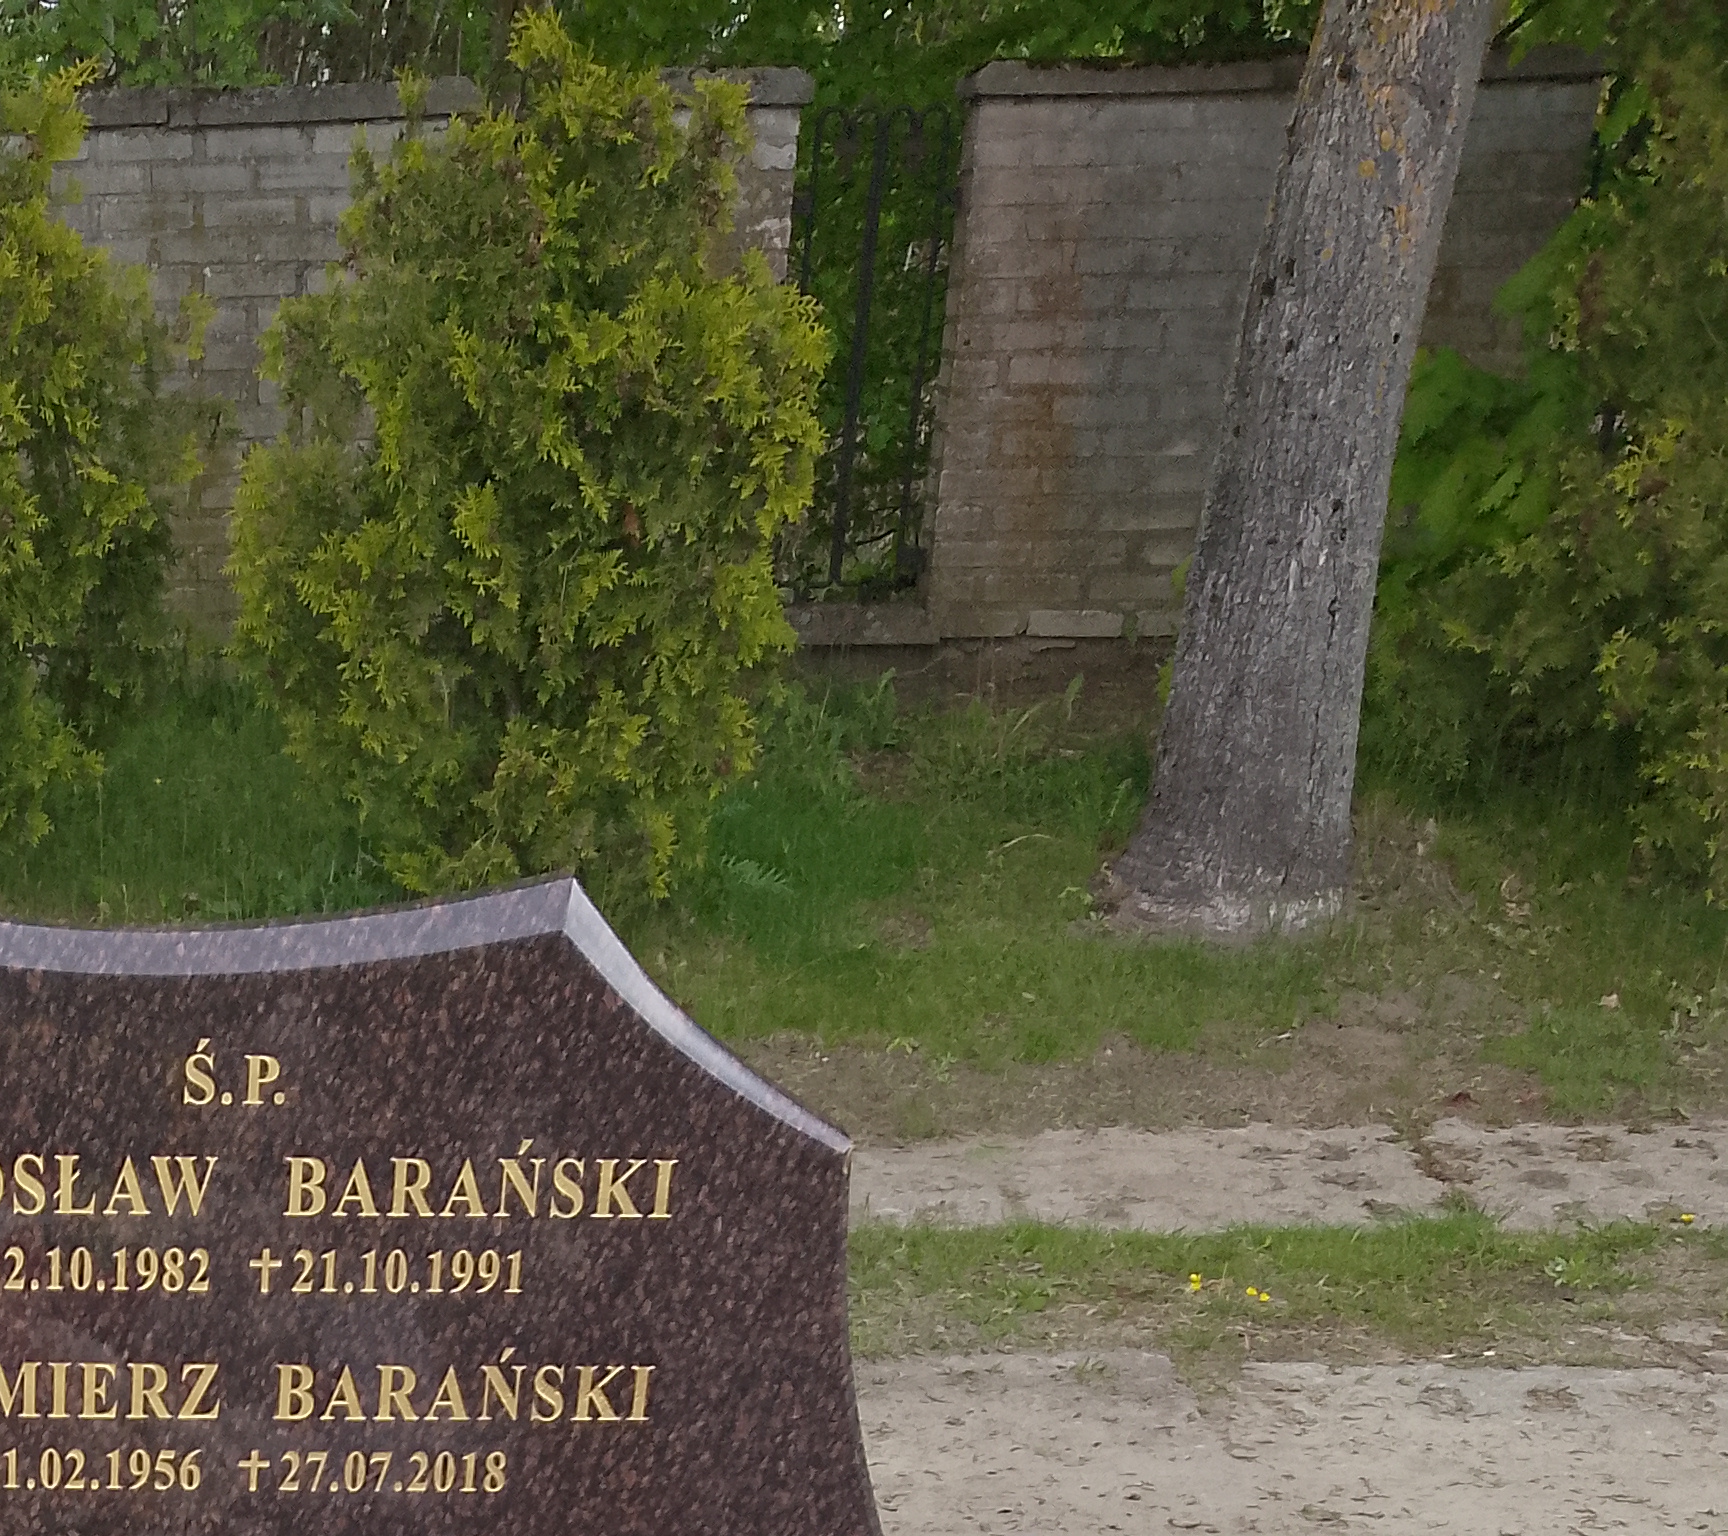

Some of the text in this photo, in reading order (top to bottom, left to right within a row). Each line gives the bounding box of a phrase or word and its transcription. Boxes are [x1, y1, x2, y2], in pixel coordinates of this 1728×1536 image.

[182, 1038, 287, 1107] Ś.P.
[283, 1138, 679, 1220] BARAŃSKI
[291, 1248, 524, 1295] 21.10.1991
[273, 1346, 656, 1423] BARAŃSKI
[279, 1449, 508, 1493] 27.07.2018
